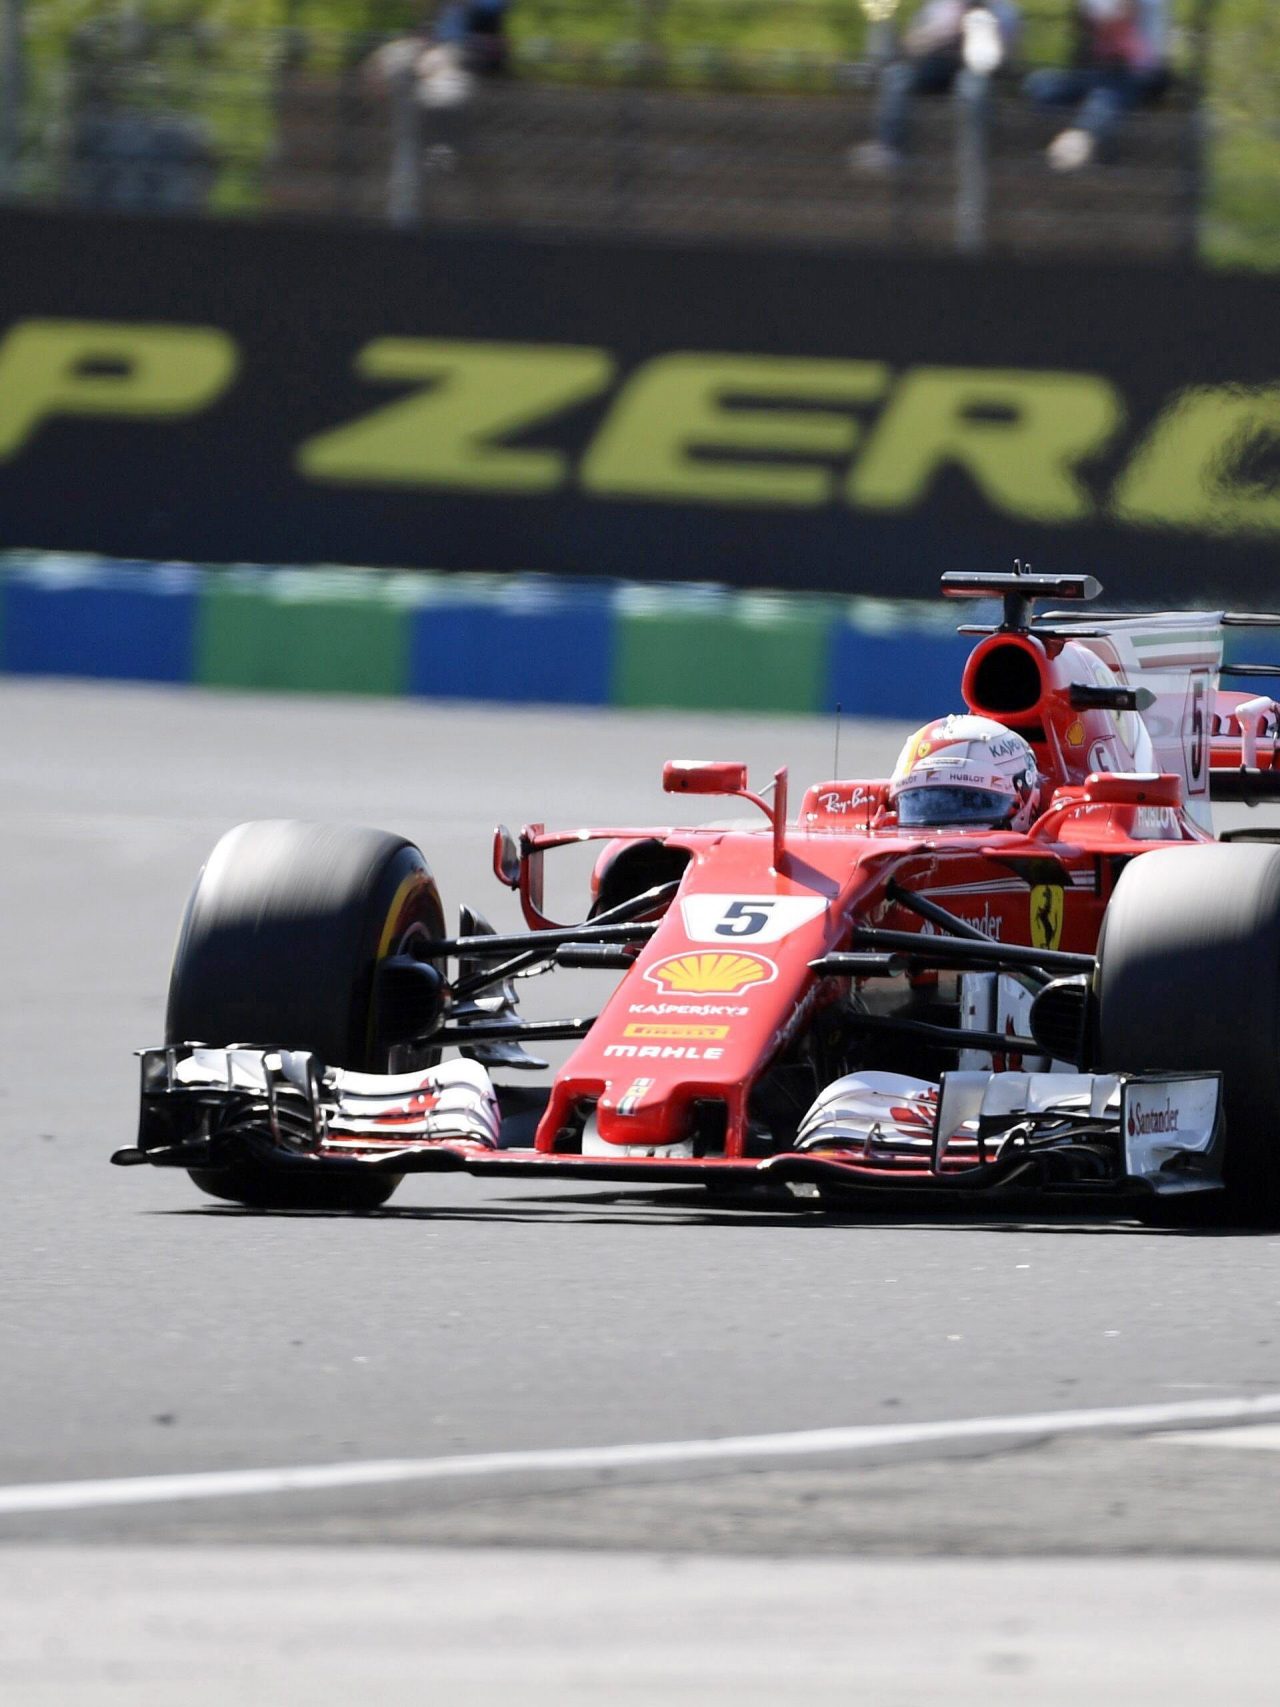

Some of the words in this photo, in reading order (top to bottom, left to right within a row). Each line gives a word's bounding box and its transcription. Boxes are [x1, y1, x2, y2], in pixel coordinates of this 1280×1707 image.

[0, 317, 239, 464] P
[949, 773, 985, 783] HUBLOT
[714, 901, 775, 937] 5
[603, 1045, 725, 1059] MAHLE
[1135, 1096, 1179, 1136] Santander
